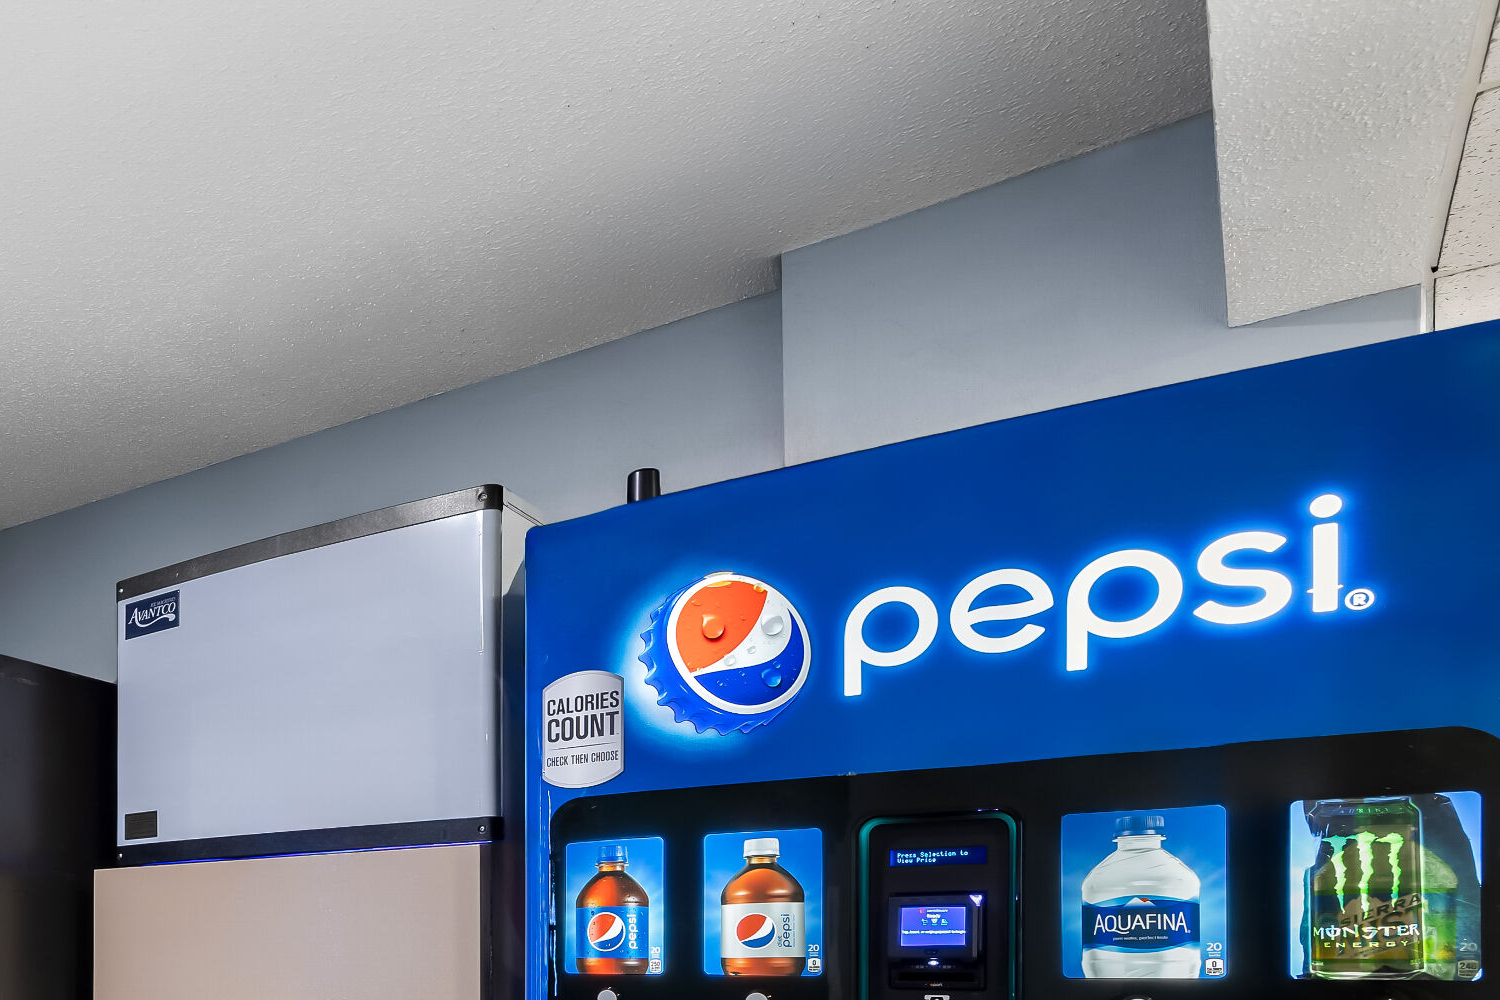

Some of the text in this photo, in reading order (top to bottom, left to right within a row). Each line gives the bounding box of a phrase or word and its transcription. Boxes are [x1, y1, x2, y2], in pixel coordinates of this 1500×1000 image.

[842, 493, 1344, 698] pepsi
[547, 690, 620, 716] CALORIES
[547, 711, 619, 743] COUNT
[546, 750, 619, 767] CHECK THEN CHOOSE
[627, 914, 638, 949] pepsi
[781, 913, 792, 948] pepsi
[1093, 911, 1189, 936] AQUAFINA
[1313, 923, 1420, 940] MONSTER
[1206, 942, 1222, 951] 20
[1324, 940, 1409, 948] ENERGY
[1460, 942, 1478, 951] 20
